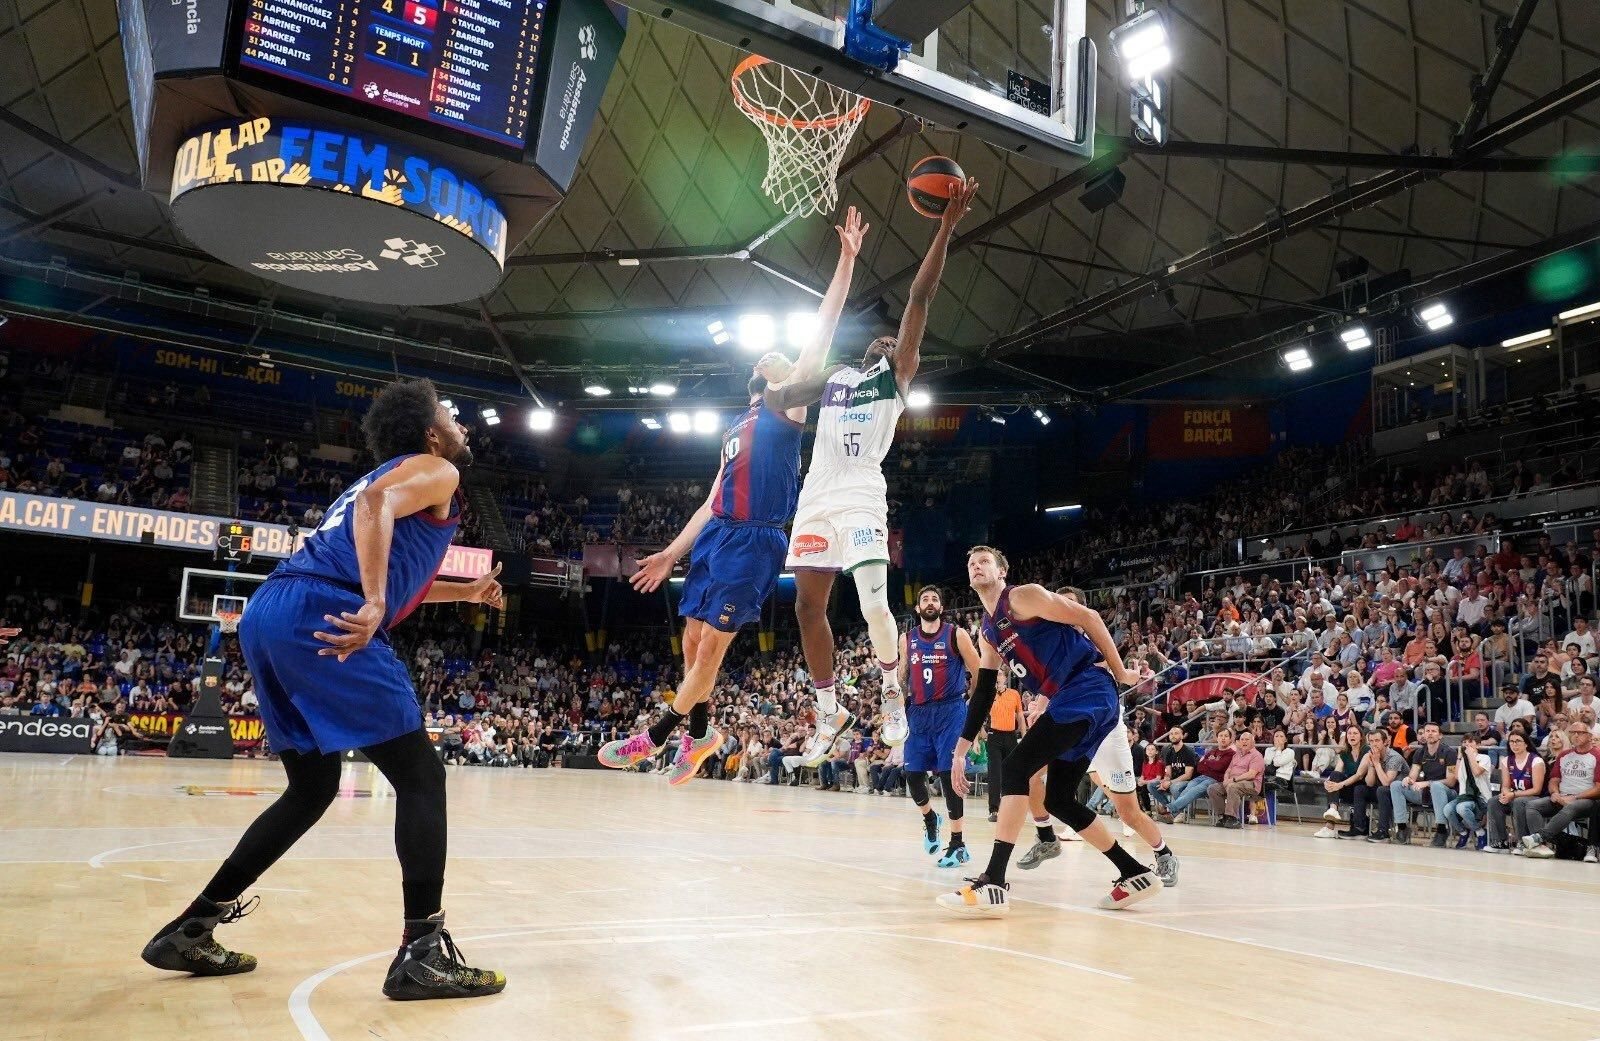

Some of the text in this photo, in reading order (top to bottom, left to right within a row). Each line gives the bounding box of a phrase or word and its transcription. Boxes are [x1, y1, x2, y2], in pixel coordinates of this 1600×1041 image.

[275, 0, 333, 19] NANGÓMEZ
[382, 0, 426, 25] 4 5
[488, 0, 512, 9] SKI
[252, 0, 264, 8] 20
[264, 3, 327, 29] LAPROVITTOLA
[350, 31, 355, 39] 2
[252, 12, 262, 20] 21
[262, 15, 302, 33] ABRINES
[458, 19, 486, 35] TAYLOR
[460, 8, 500, 28] KALINOSKI
[250, 24, 260, 33] 22
[261, 28, 296, 44] PARKER
[343, 53, 354, 62] 22
[375, 26, 426, 49] TEMPS MORT
[456, 31, 494, 49] BARREIRO
[248, 36, 259, 45] 31
[259, 38, 311, 61] JOKUBAITIS
[376, 41, 418, 66] 2 1
[454, 42, 483, 58] CARTER
[245, 48, 256, 57] 44
[257, 51, 287, 67] PARRA
[329, 73, 335, 81] 0
[443, 50, 452, 59] 14
[452, 53, 489, 71] DJEDOVIC
[451, 63, 470, 76] LIMA
[449, 75, 481, 91] THOMAS
[436, 94, 445, 103] 55
[446, 98, 471, 111] PERRY
[448, 86, 480, 102] KRAVISH
[518, 109, 527, 117] 10
[434, 106, 444, 114] 77
[444, 108, 464, 120] SIMA
[280, 126, 388, 192] FEM
[154, 350, 218, 374] SOM-HI
[1184, 410, 1232, 426] FORÇA
[1184, 428, 1232, 445] BARÇA
[0, 497, 75, 530] A.CAT
[91, 507, 215, 546] ENTRADES
[923, 668, 933, 684] 9
[1010, 658, 1027, 678] 6
[0, 718, 90, 739] endesa
